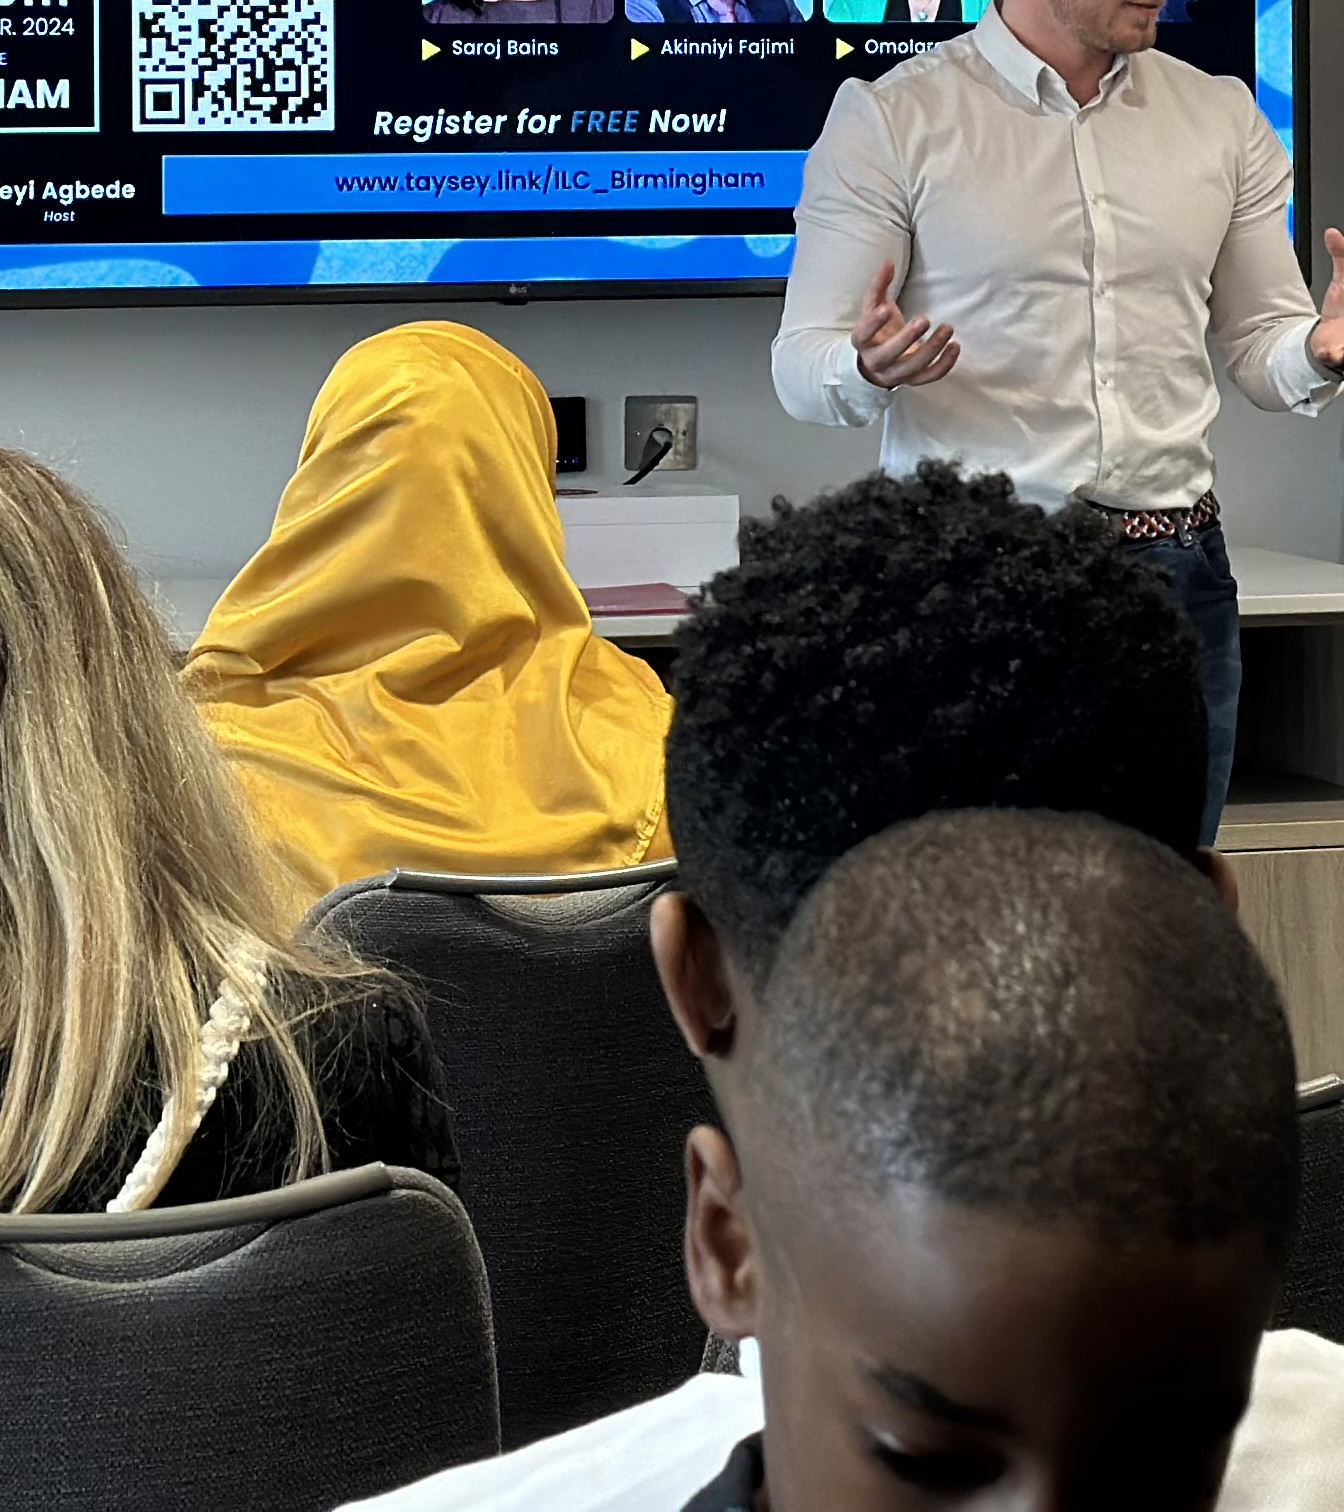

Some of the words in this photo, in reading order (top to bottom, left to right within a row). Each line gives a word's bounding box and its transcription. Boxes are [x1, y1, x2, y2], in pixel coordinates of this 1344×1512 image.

[23, 17, 74, 35] 2024
[452, 39, 500, 59] Saroj
[508, 39, 558, 55] Bains
[661, 39, 732, 59] Akinniyi
[739, 39, 794, 59] Fajimi
[865, 39, 940, 54] Omolar
[374, 109, 507, 142] Register
[517, 108, 561, 134] for
[571, 110, 639, 132] FREE
[649, 109, 726, 132] Now!
[335, 164, 764, 198] www.taysey.link/ILC_Birmingham
[42, 180, 136, 206] Agbede
[44, 211, 75, 221] Host
